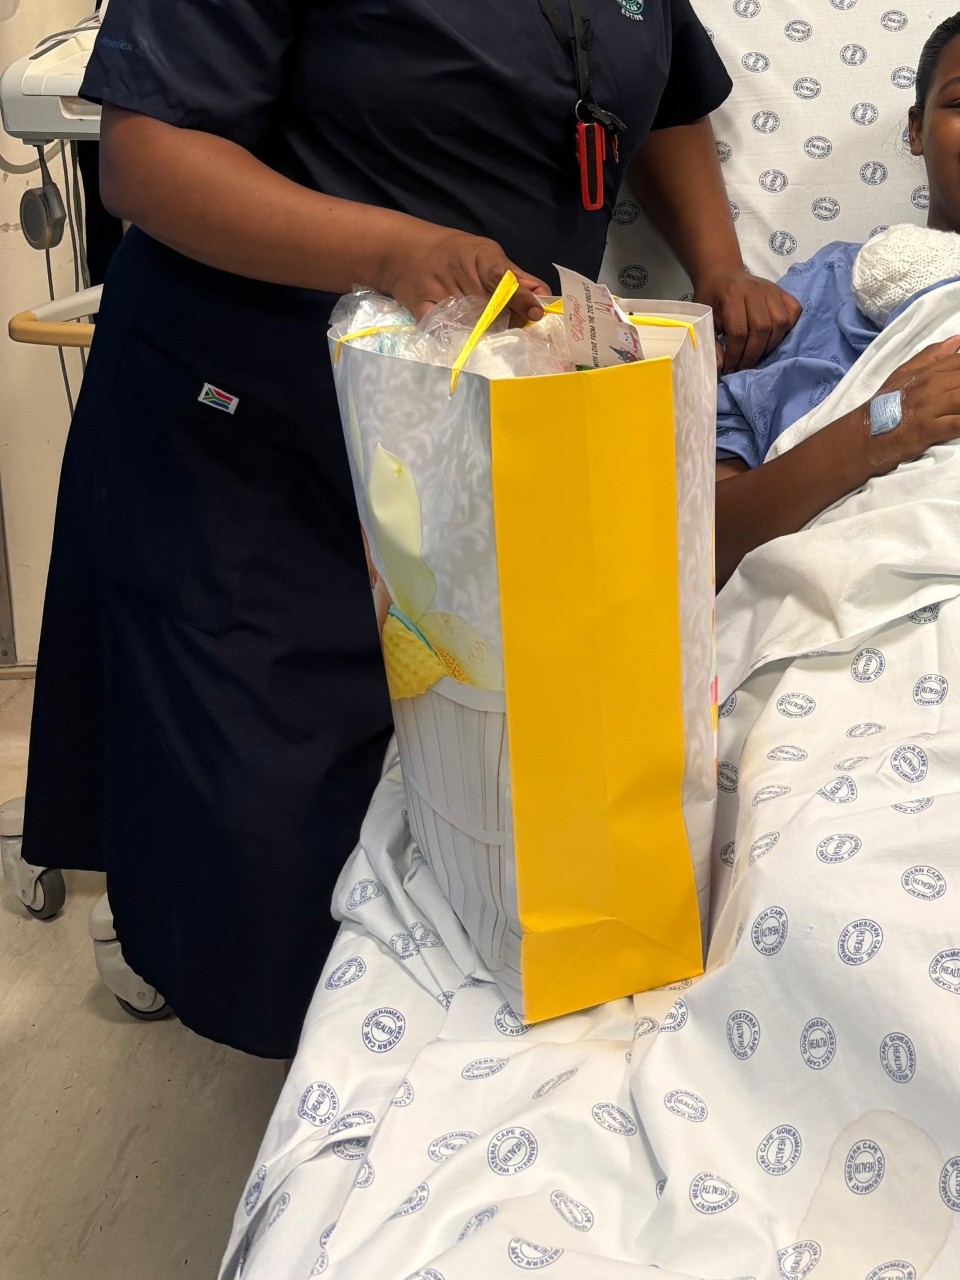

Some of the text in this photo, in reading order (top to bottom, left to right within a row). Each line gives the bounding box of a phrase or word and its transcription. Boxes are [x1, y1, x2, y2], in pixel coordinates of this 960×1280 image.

[582, 281, 593, 303] PROJECT
[586, 303, 595, 314] ZOE
[588, 315, 596, 325] THE
[589, 325, 598, 341] FROM
[590, 341, 599, 356] LOVE
[755, 909, 786, 953] WESTERN CAPE GOVERNMENT
[761, 925, 779, 938] HEALTH
[840, 921, 880, 963] WESTERN CAPE GOVERNMENT
[853, 930, 866, 954] HEALTH
[933, 976, 951, 992] CAPE
[364, 1009, 403, 1049] WESTERN CAPE GOVERNMENT
[373, 1019, 394, 1037] HEALTH
[802, 1020, 834, 1067] WESTERN CAPE GOVERNMENT
[809, 1037, 827, 1049] HEALTH
[881, 1035, 914, 1082] WESTERN CAPE GOVERNMENT
[893, 1045, 903, 1072] HEALTH
[489, 1129, 535, 1174] WESTERN CAPE GOVERNMENT
[501, 1140, 525, 1164] HEALTH
[760, 1127, 799, 1174] WESTERN CAPE GOVERNMENT
[774, 1137, 787, 1164] HEALTH
[846, 1142, 883, 1192] WESTERN CAPE GOVERNMENT
[854, 1161, 875, 1174] HEALTH
